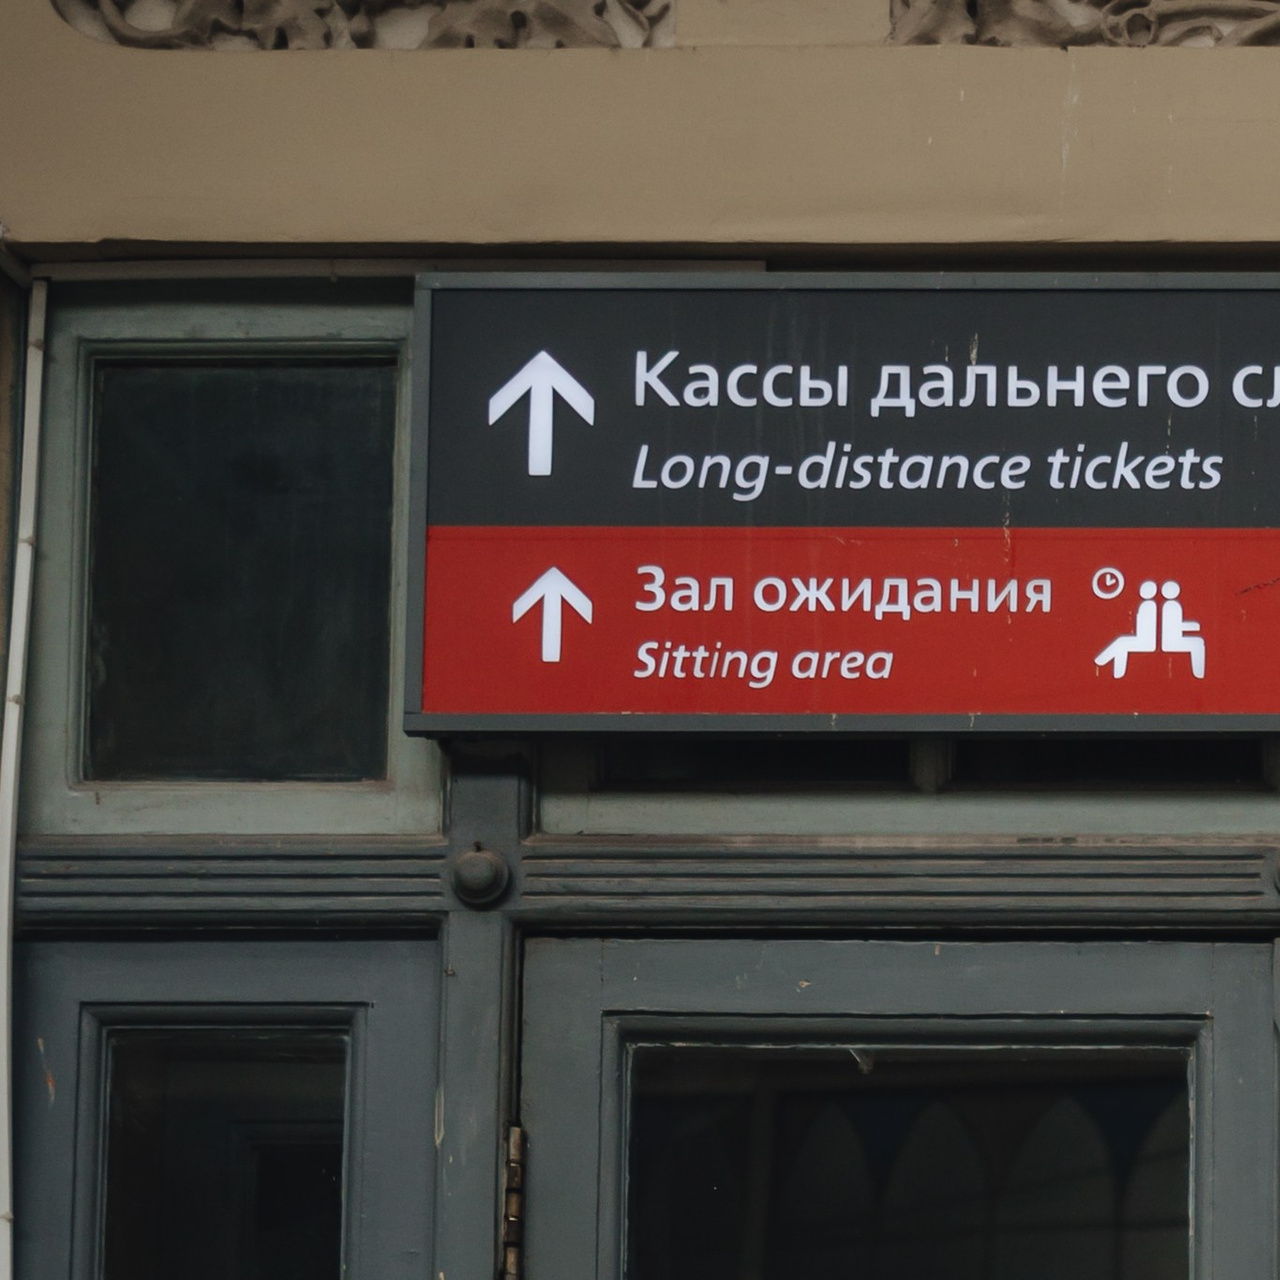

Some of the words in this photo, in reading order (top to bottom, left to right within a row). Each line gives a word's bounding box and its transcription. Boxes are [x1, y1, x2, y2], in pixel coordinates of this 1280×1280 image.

[636, 350, 848, 408] Кассы
[870, 364, 1209, 418] дальнего
[632, 441, 1031, 502] Long-distance
[1047, 441, 1224, 490] tickets
[635, 565, 734, 612] Зал
[753, 577, 1053, 621] ожидания
[633, 641, 778, 689] Sitting
[791, 651, 894, 680] area
